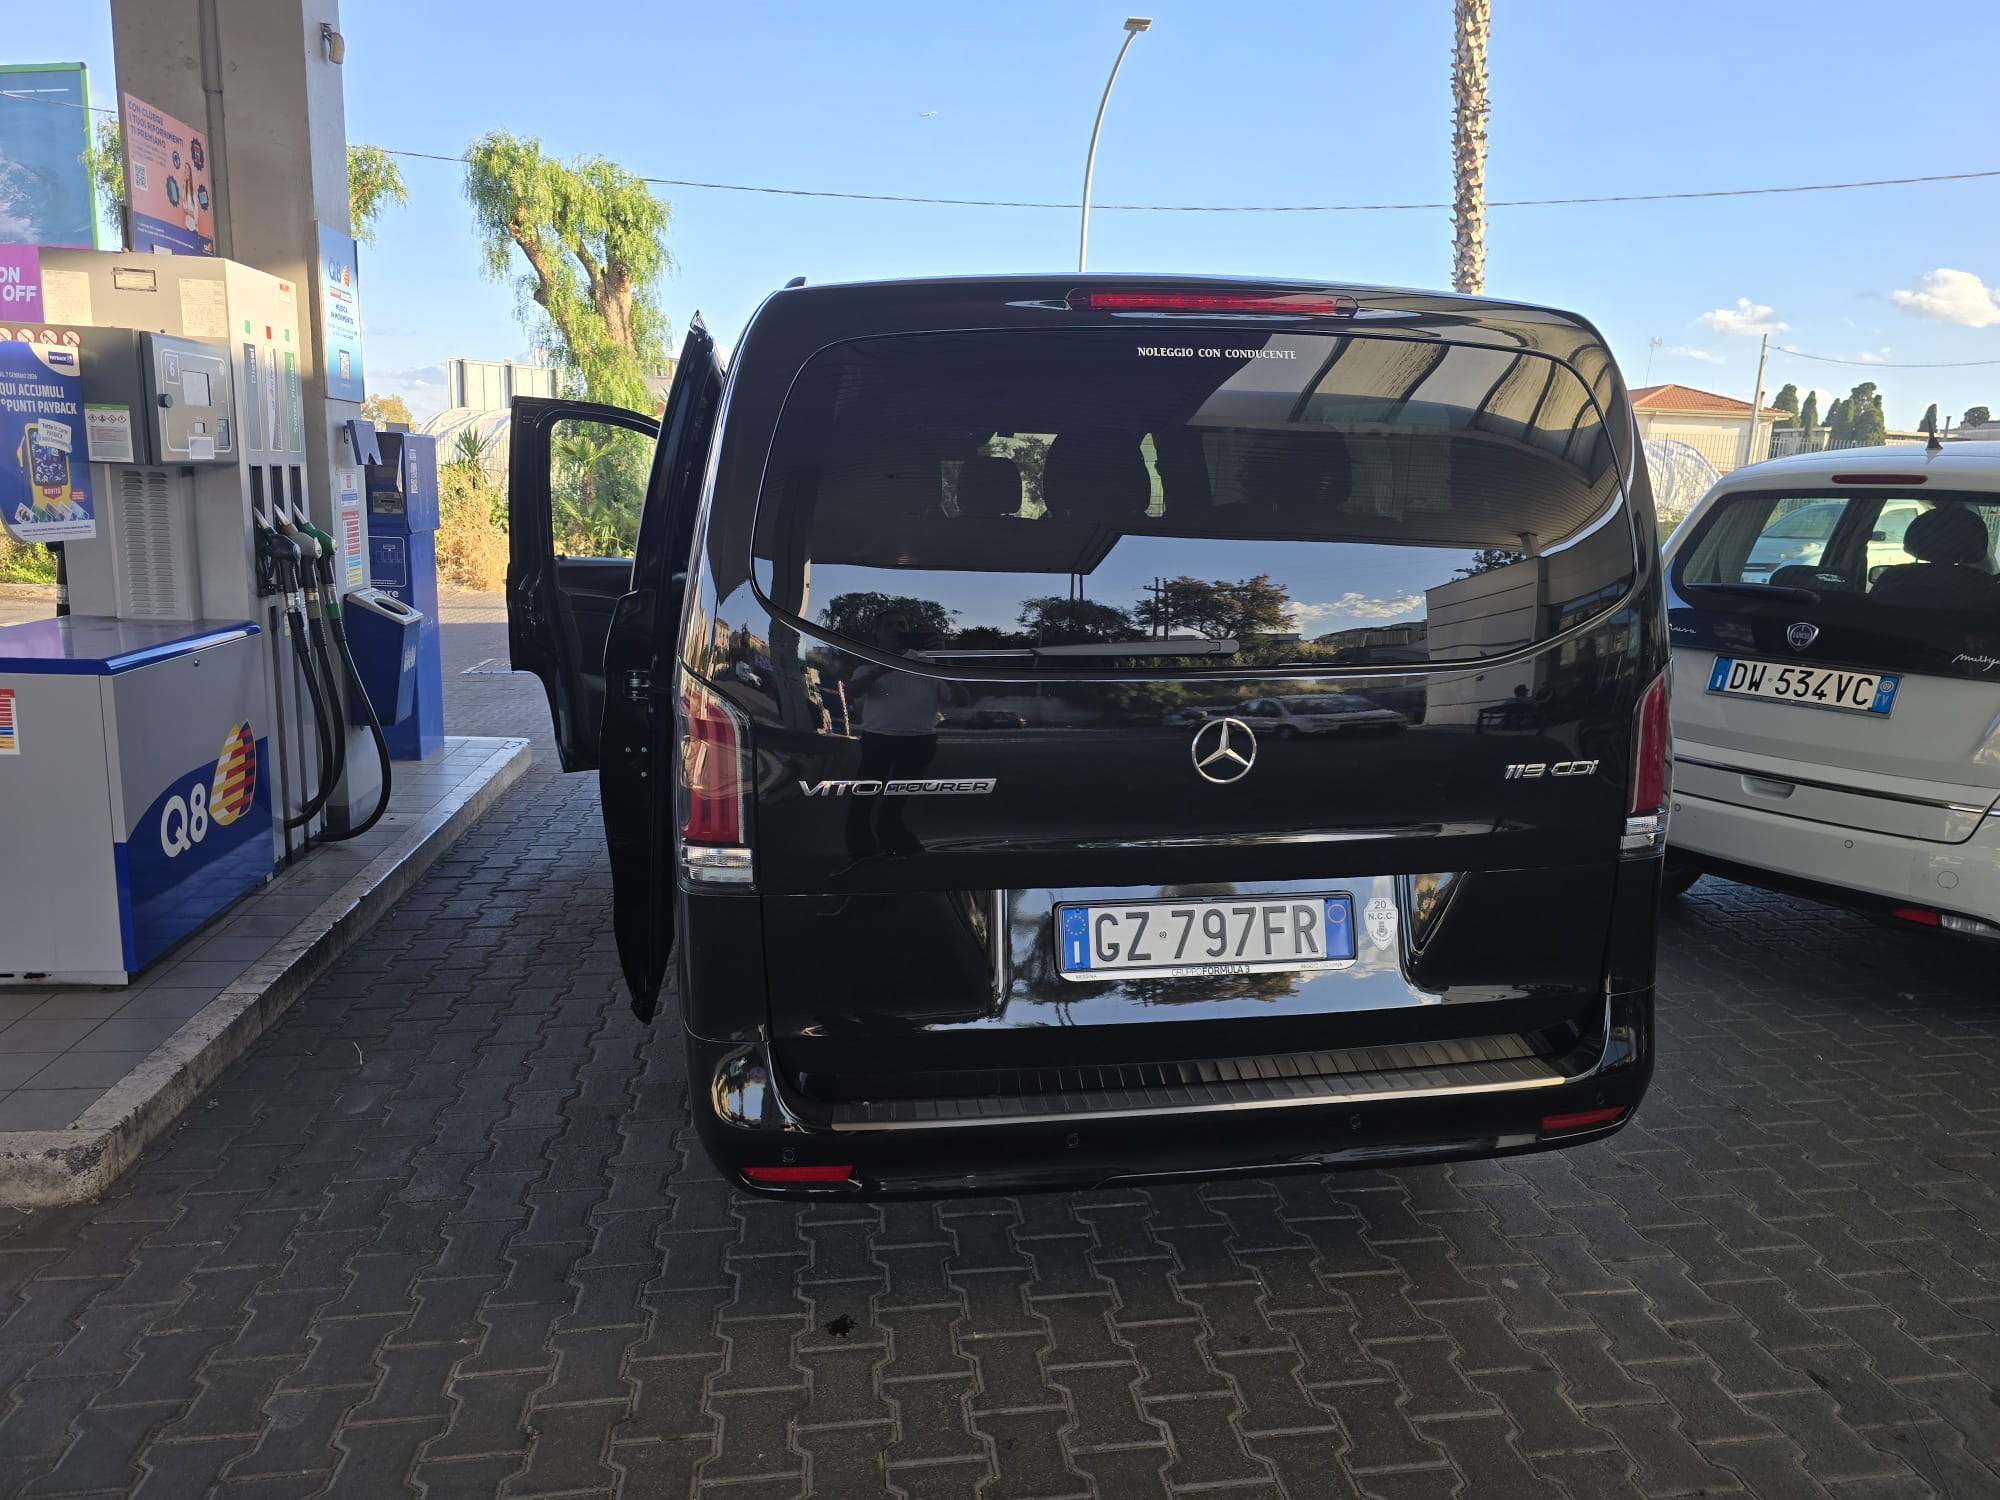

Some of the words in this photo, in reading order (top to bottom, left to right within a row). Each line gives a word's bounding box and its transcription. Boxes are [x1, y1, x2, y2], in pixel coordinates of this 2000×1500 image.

[2, 285, 37, 302] OFF
[1137, 347, 1194, 357] NOLEGGIO
[1198, 348, 1221, 358] CON
[1225, 349, 1297, 360] CONDUCENTE
[169, 361, 175, 377] 6
[249, 347, 257, 384] Diesel
[0, 383, 16, 397] QUI
[19, 384, 65, 398] ACCUMULI
[38, 401, 78, 415] PAYBACK
[1729, 662, 1768, 692] DW
[1774, 668, 1874, 706] 534VC
[1505, 763, 1547, 780] 119
[798, 780, 883, 796] VITO
[888, 781, 990, 795] TOURER
[160, 783, 208, 858] Q8
[1374, 900, 1387, 910] 20
[1368, 912, 1395, 921] N.C.C.
[1095, 911, 1152, 962] GZ
[1170, 904, 1320, 960] 797FR
